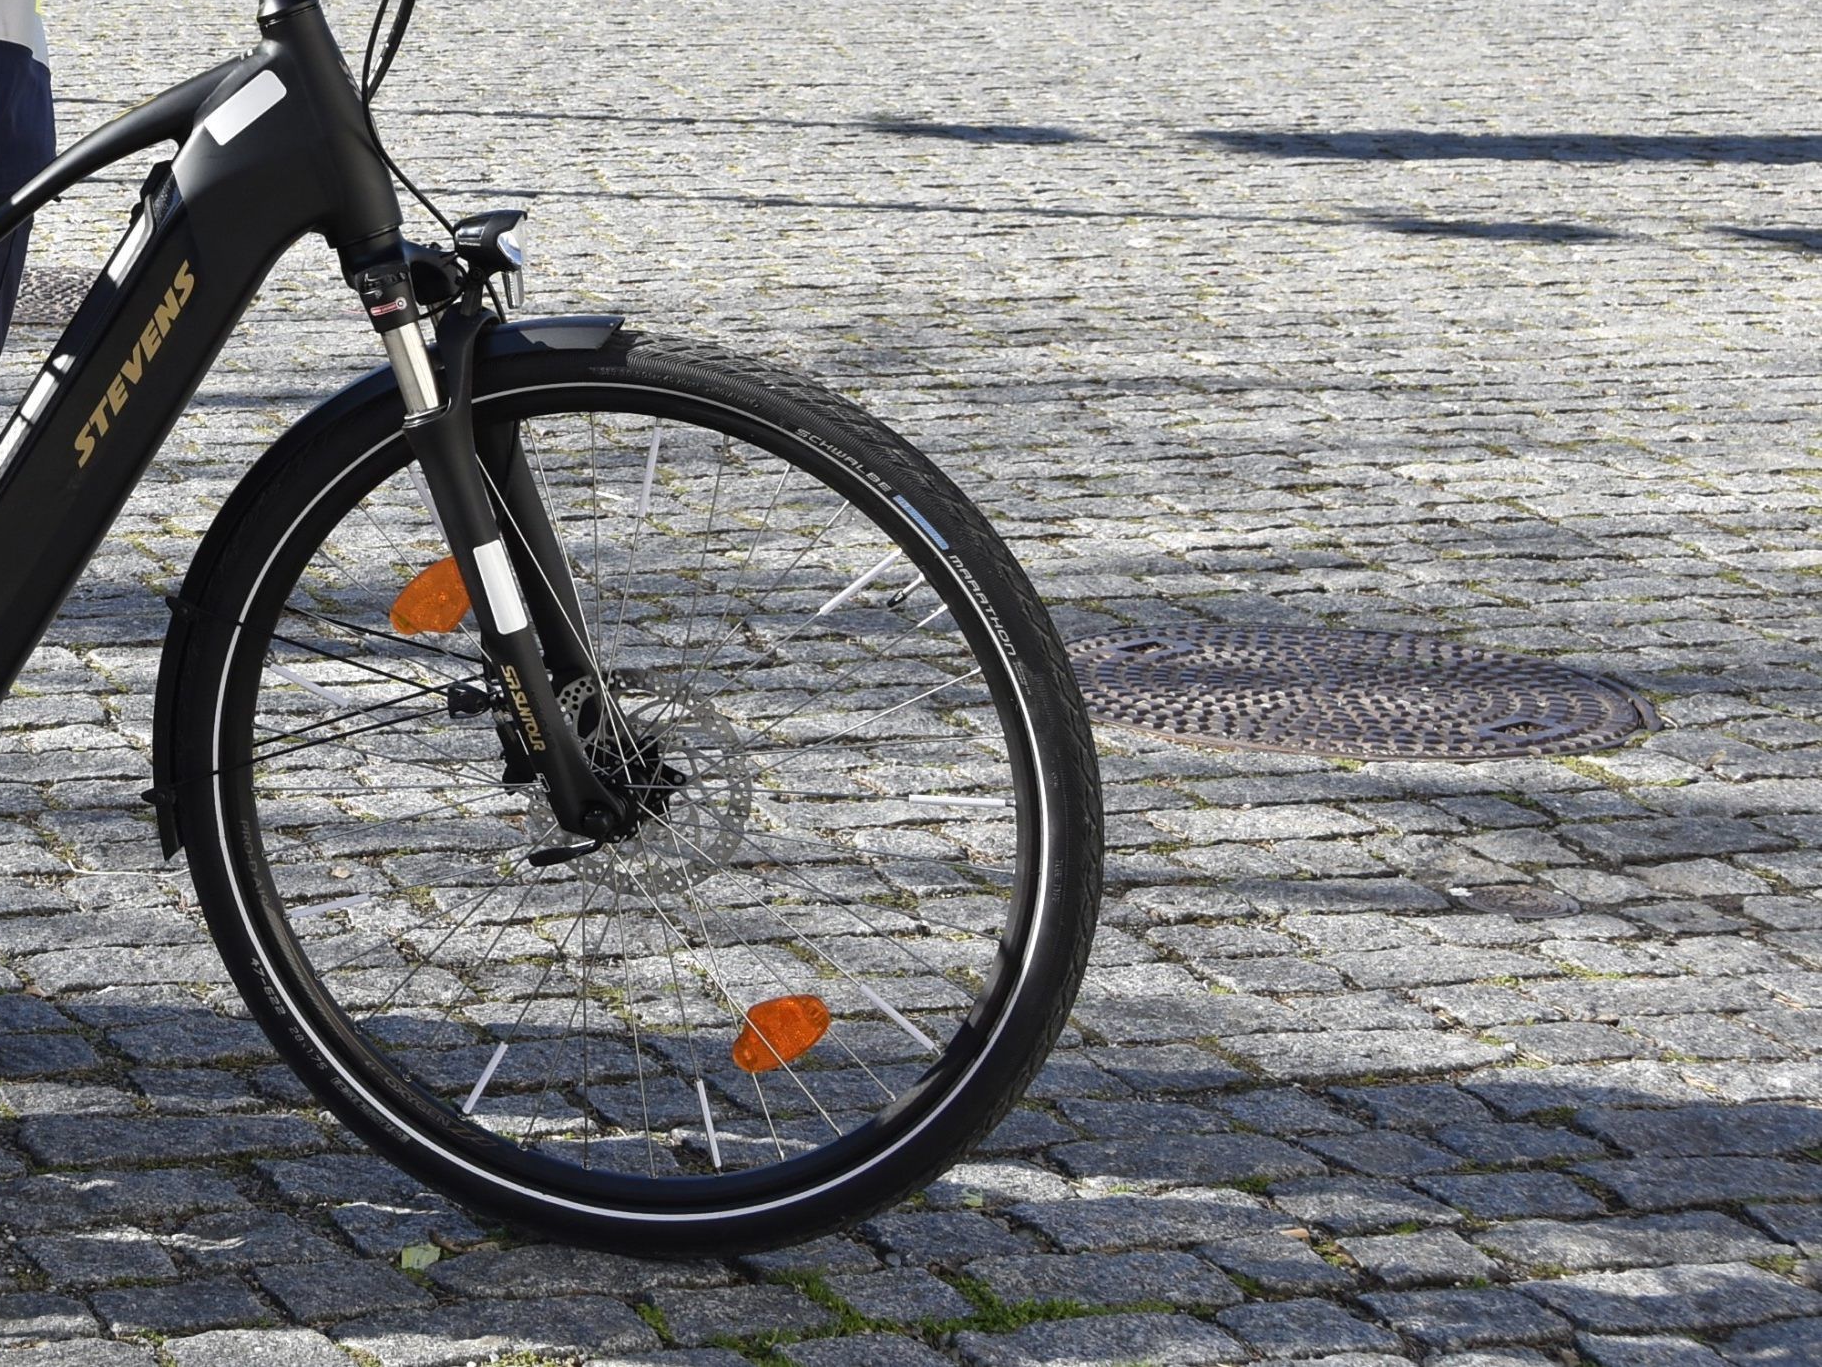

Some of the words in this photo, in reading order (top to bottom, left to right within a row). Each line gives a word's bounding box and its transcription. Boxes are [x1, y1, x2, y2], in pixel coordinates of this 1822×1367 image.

[73, 258, 195, 469] STEVENS
[793, 427, 893, 494] SCHWALBE
[947, 554, 1017, 657] MARATHON
[251, 956, 287, 1018] 47-622
